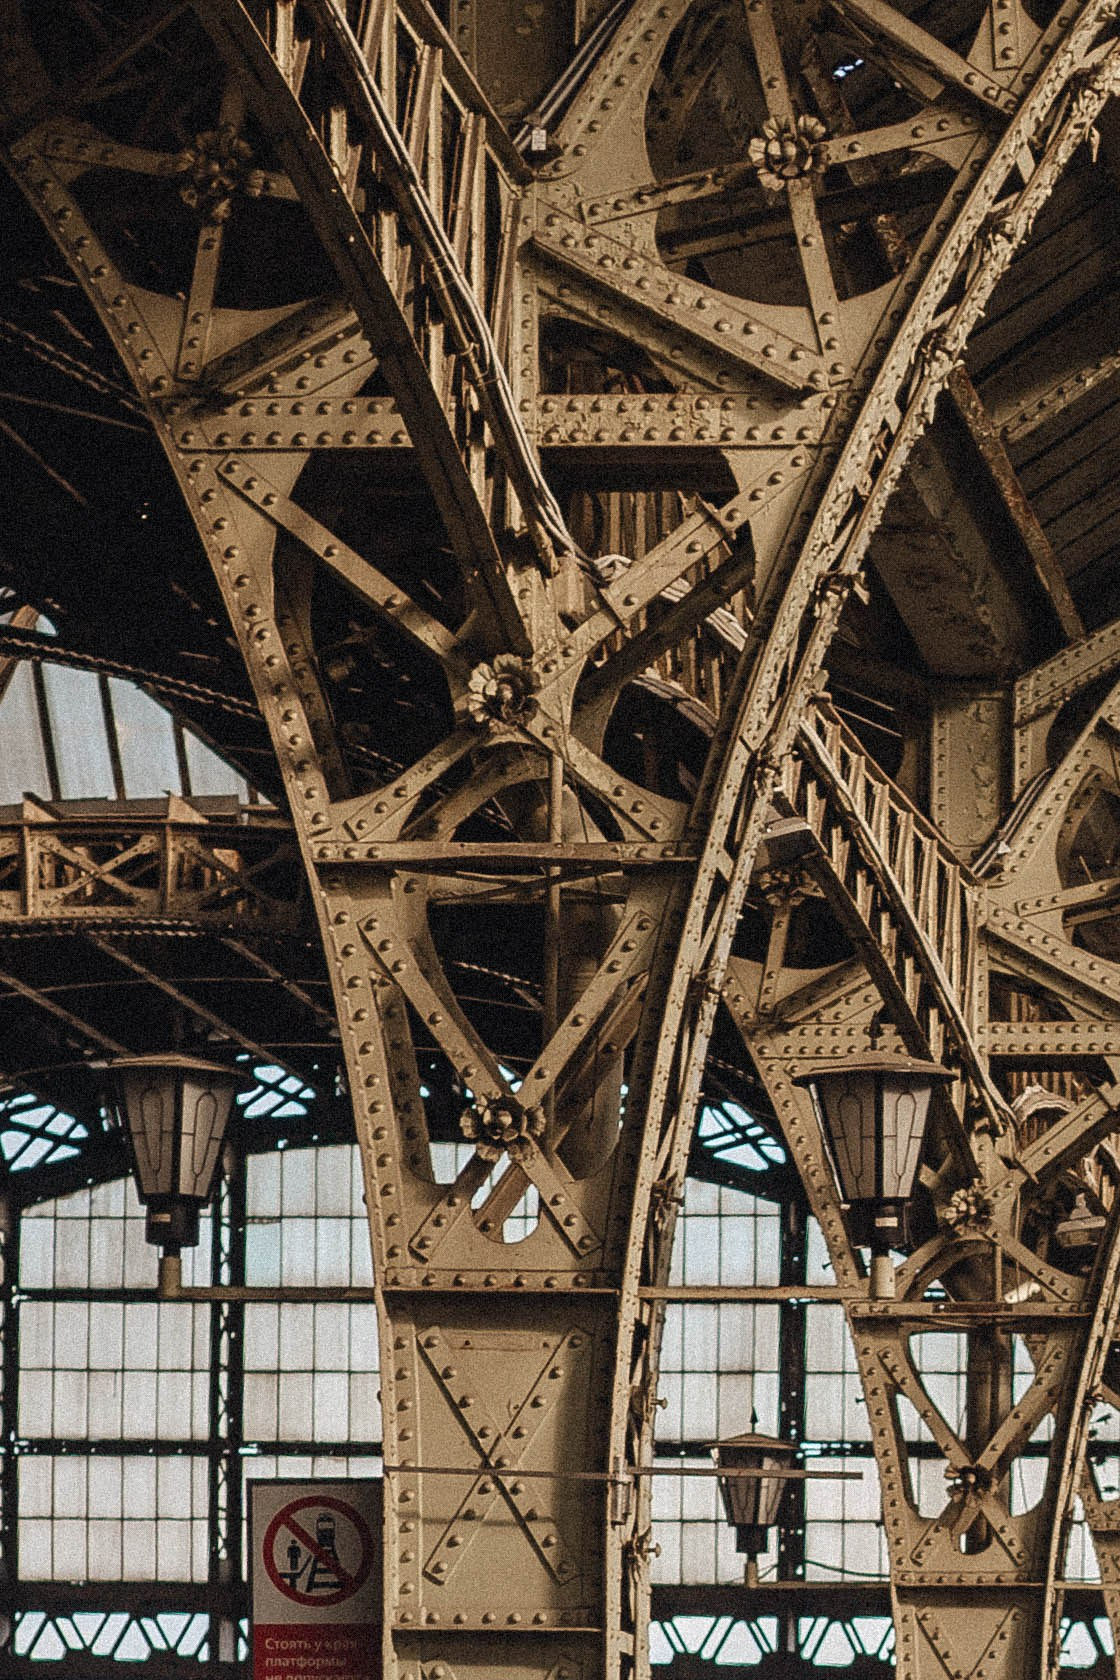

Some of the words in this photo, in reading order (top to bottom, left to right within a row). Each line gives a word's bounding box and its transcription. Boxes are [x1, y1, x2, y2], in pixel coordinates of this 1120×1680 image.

[265, 1637, 312, 1650] Стоять
[314, 1641, 323, 1653] у
[265, 1656, 347, 1669] платформы
